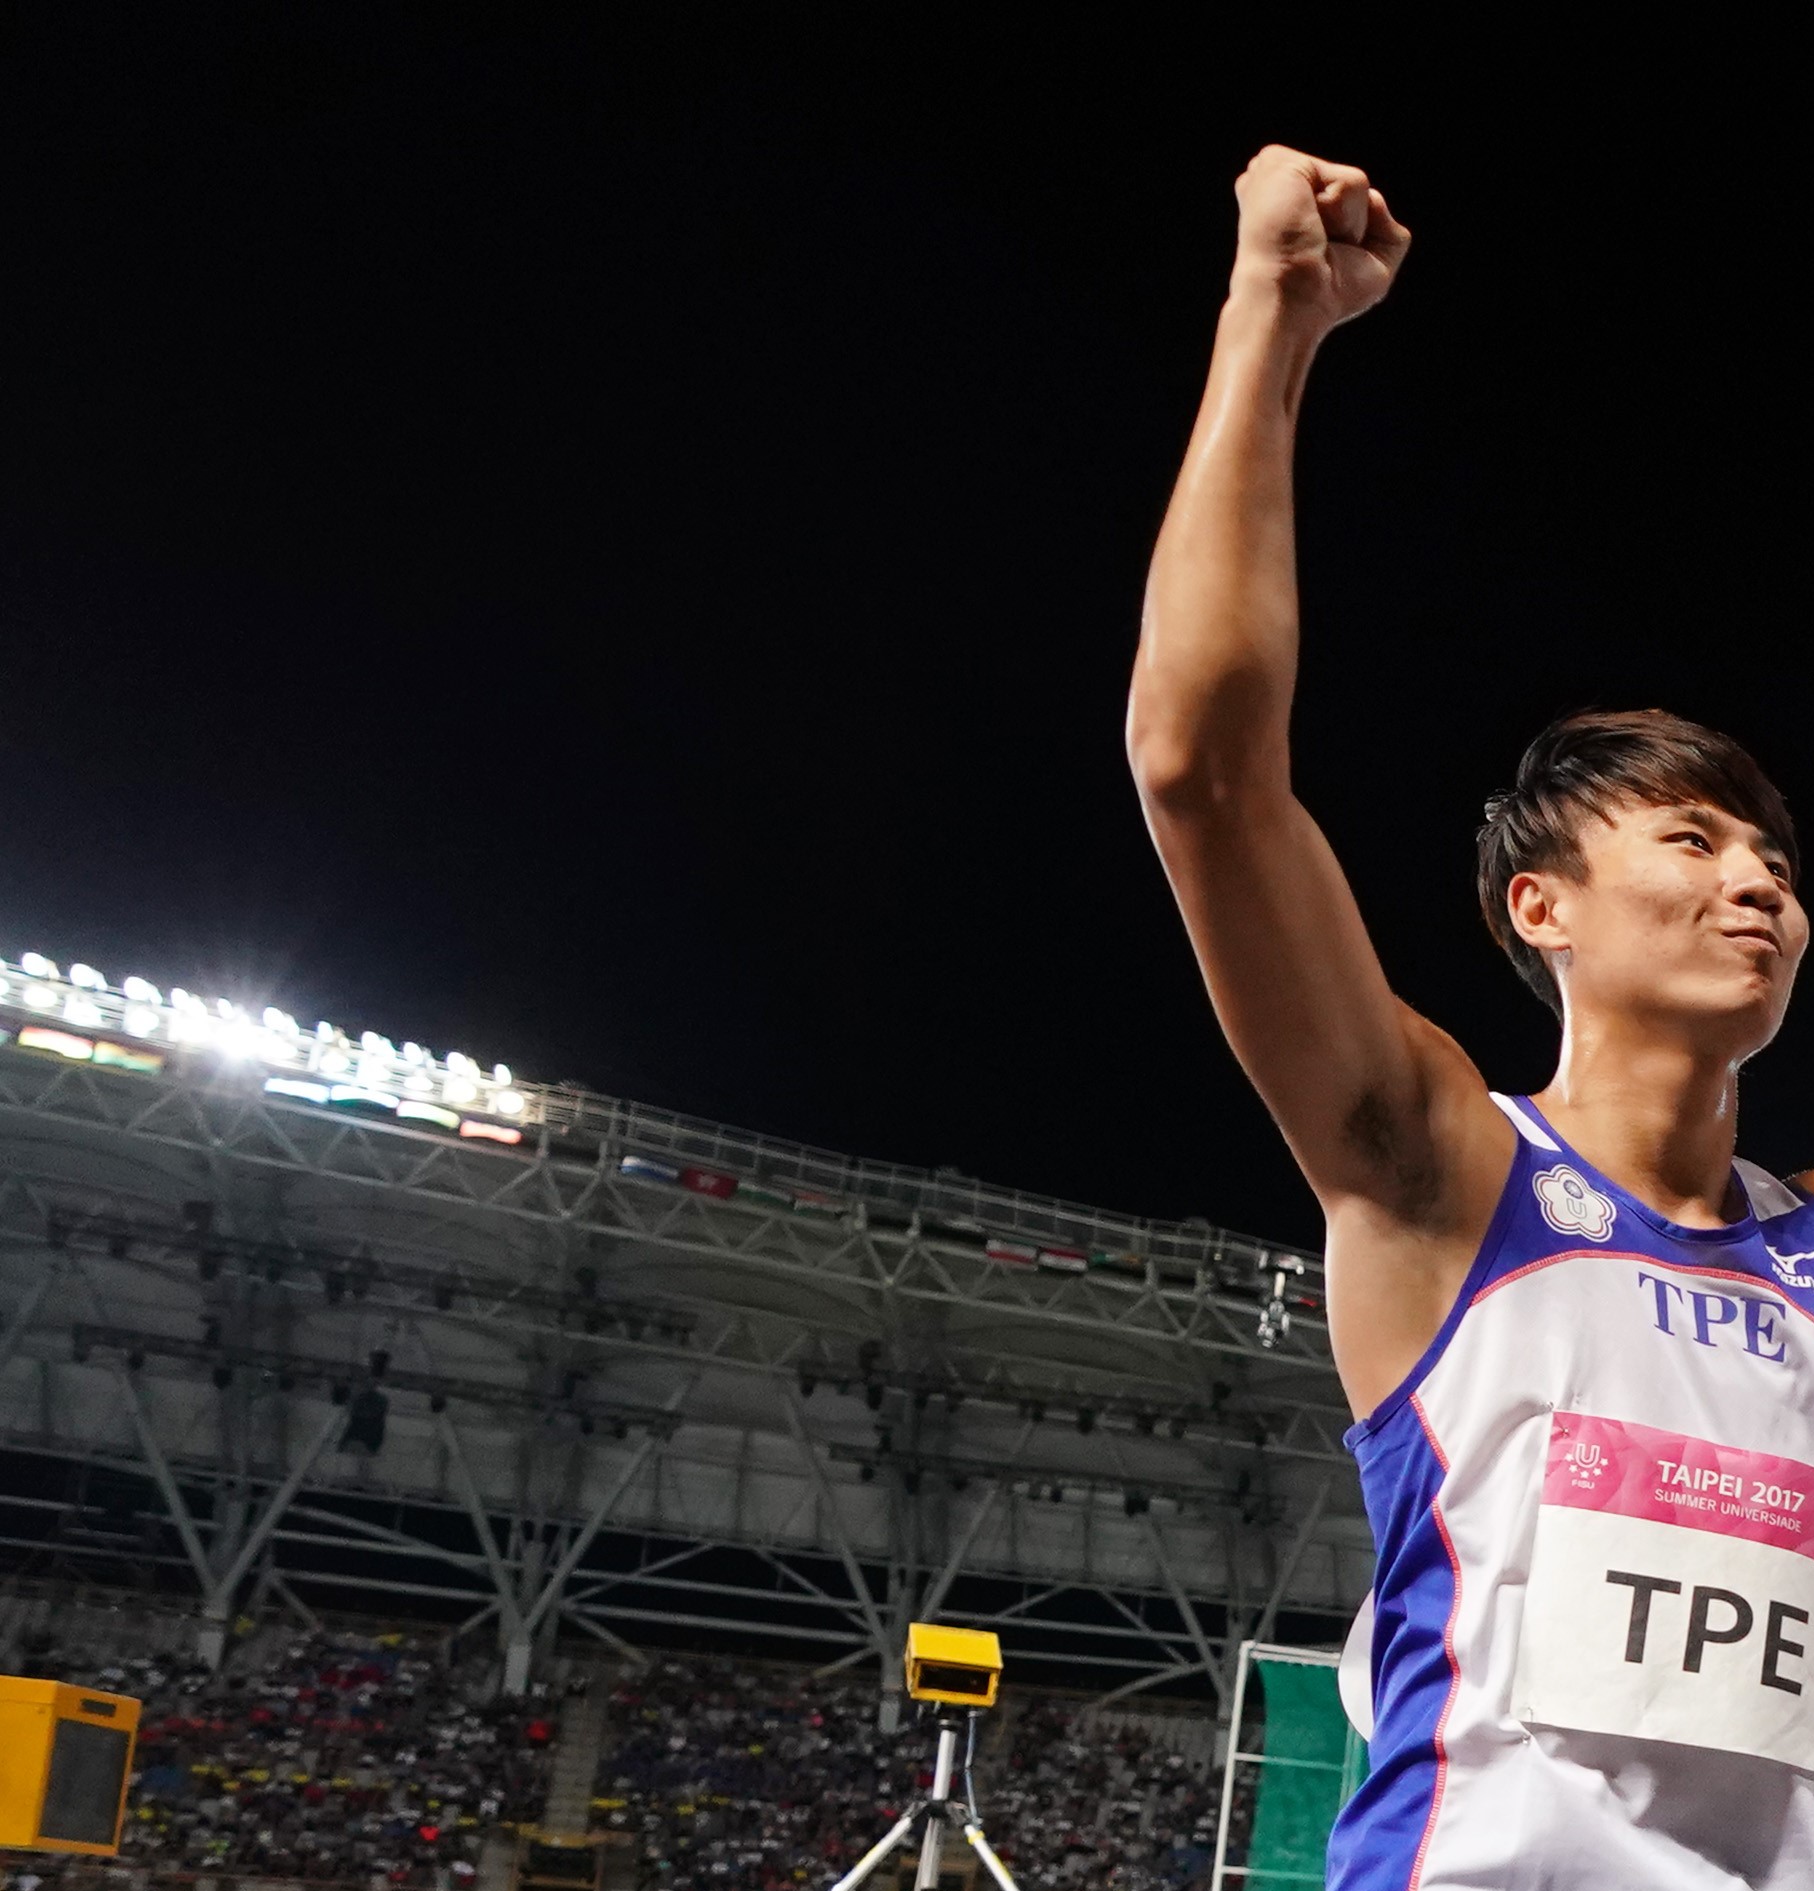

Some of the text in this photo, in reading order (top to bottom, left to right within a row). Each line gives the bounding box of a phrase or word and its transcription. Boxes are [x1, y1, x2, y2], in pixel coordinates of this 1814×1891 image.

[1638, 1271, 1787, 1364] TPE
[1654, 1488, 1717, 1513] SUMMER
[1720, 1501, 1803, 1534] UNIVERSIADE
[1657, 1459, 1805, 1513] TAIPEI 2017
[1606, 1570, 1809, 1697] TPE
